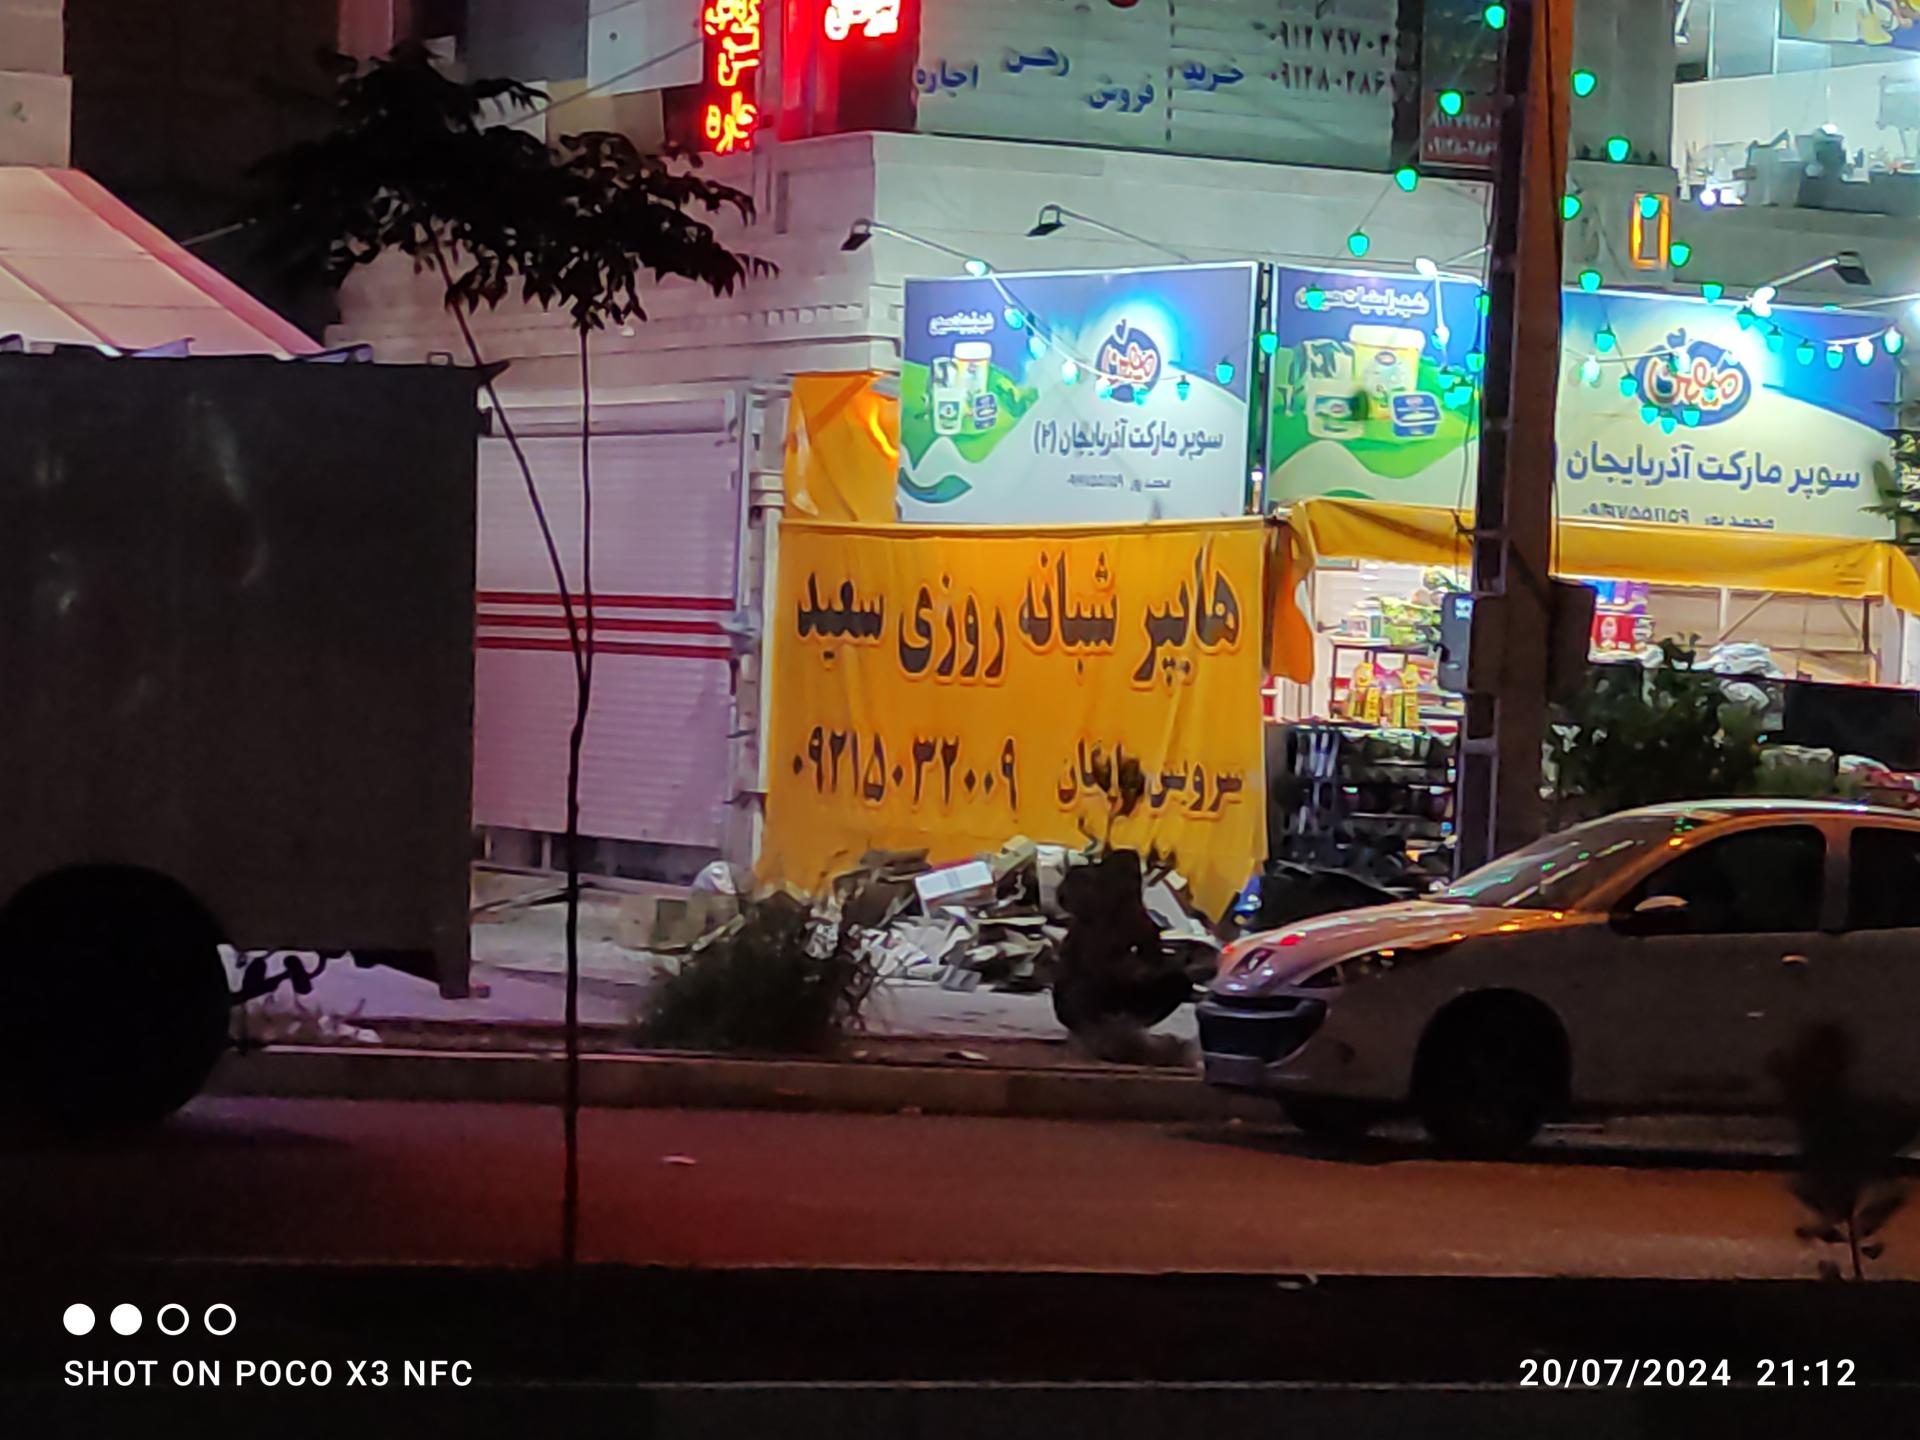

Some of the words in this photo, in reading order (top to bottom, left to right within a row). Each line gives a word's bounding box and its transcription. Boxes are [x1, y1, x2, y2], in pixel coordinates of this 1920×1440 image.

[916, 60, 979, 98] اجاره
[1086, 73, 1155, 113] فروش
[1181, 56, 1245, 92] خرید
[1059, 419, 1129, 457] آذربایجان
[1128, 421, 1178, 456] مارکت
[1178, 430, 1224, 460] سوپر
[1565, 439, 1695, 486] آذربایجان
[1696, 450, 1783, 491] مارکت
[1786, 463, 1861, 499] سوپر
[797, 571, 884, 661] سعید
[898, 568, 1005, 680] روزی
[1018, 550, 1118, 676] شبانه
[1132, 544, 1240, 689] هایپر
[792, 725, 1017, 812] ۰۹۲۱۵۰۳۲۰۰۹
[1150, 761, 1243, 813] سرویس
